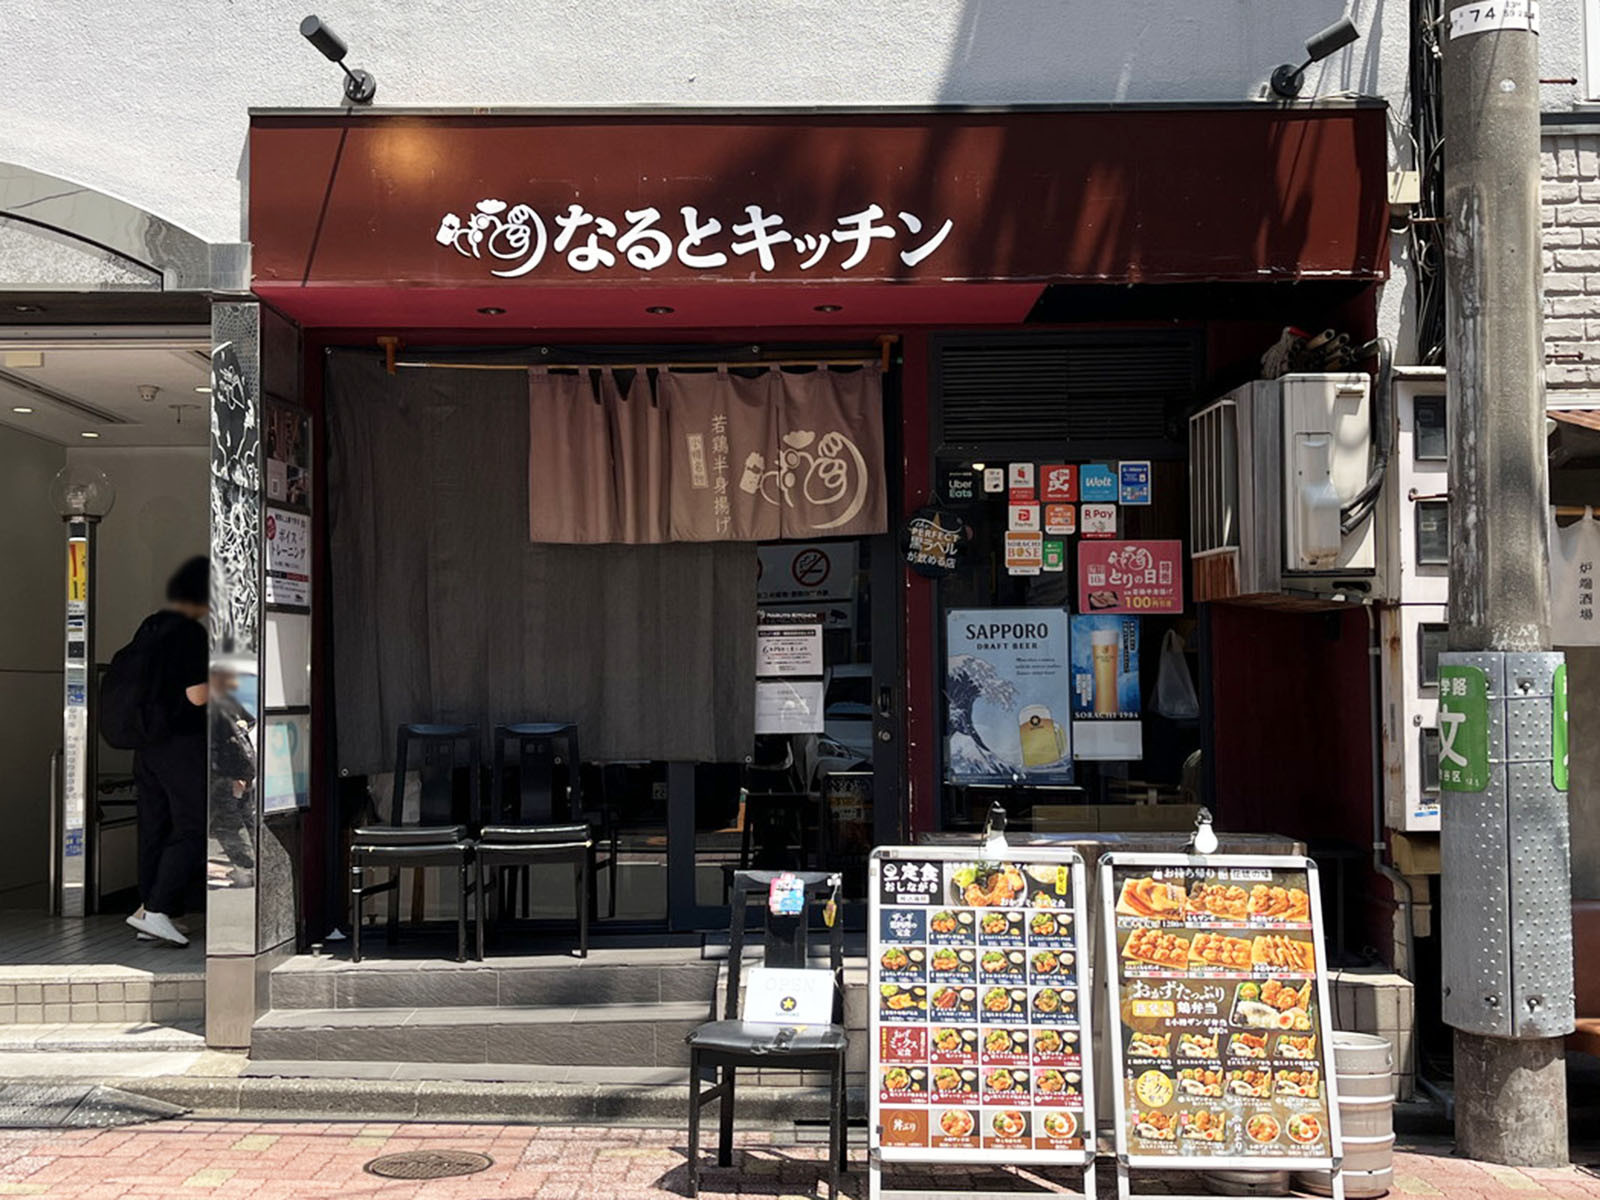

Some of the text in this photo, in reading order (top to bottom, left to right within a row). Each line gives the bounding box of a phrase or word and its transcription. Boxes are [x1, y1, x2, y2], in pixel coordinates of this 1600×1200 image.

[1469, 7, 1496, 22] 74
[554, 203, 954, 271] なるとキッチン
[948, 480, 973, 489] Uber
[1085, 476, 1112, 487] Wolt
[948, 489, 973, 498] Eats
[911, 527, 960, 542] PERFECT
[1109, 568, 1157, 588] とりの日
[966, 623, 1048, 640] SAPPORO
[901, 863, 939, 883] 定食
[885, 882, 938, 893] おしながき
